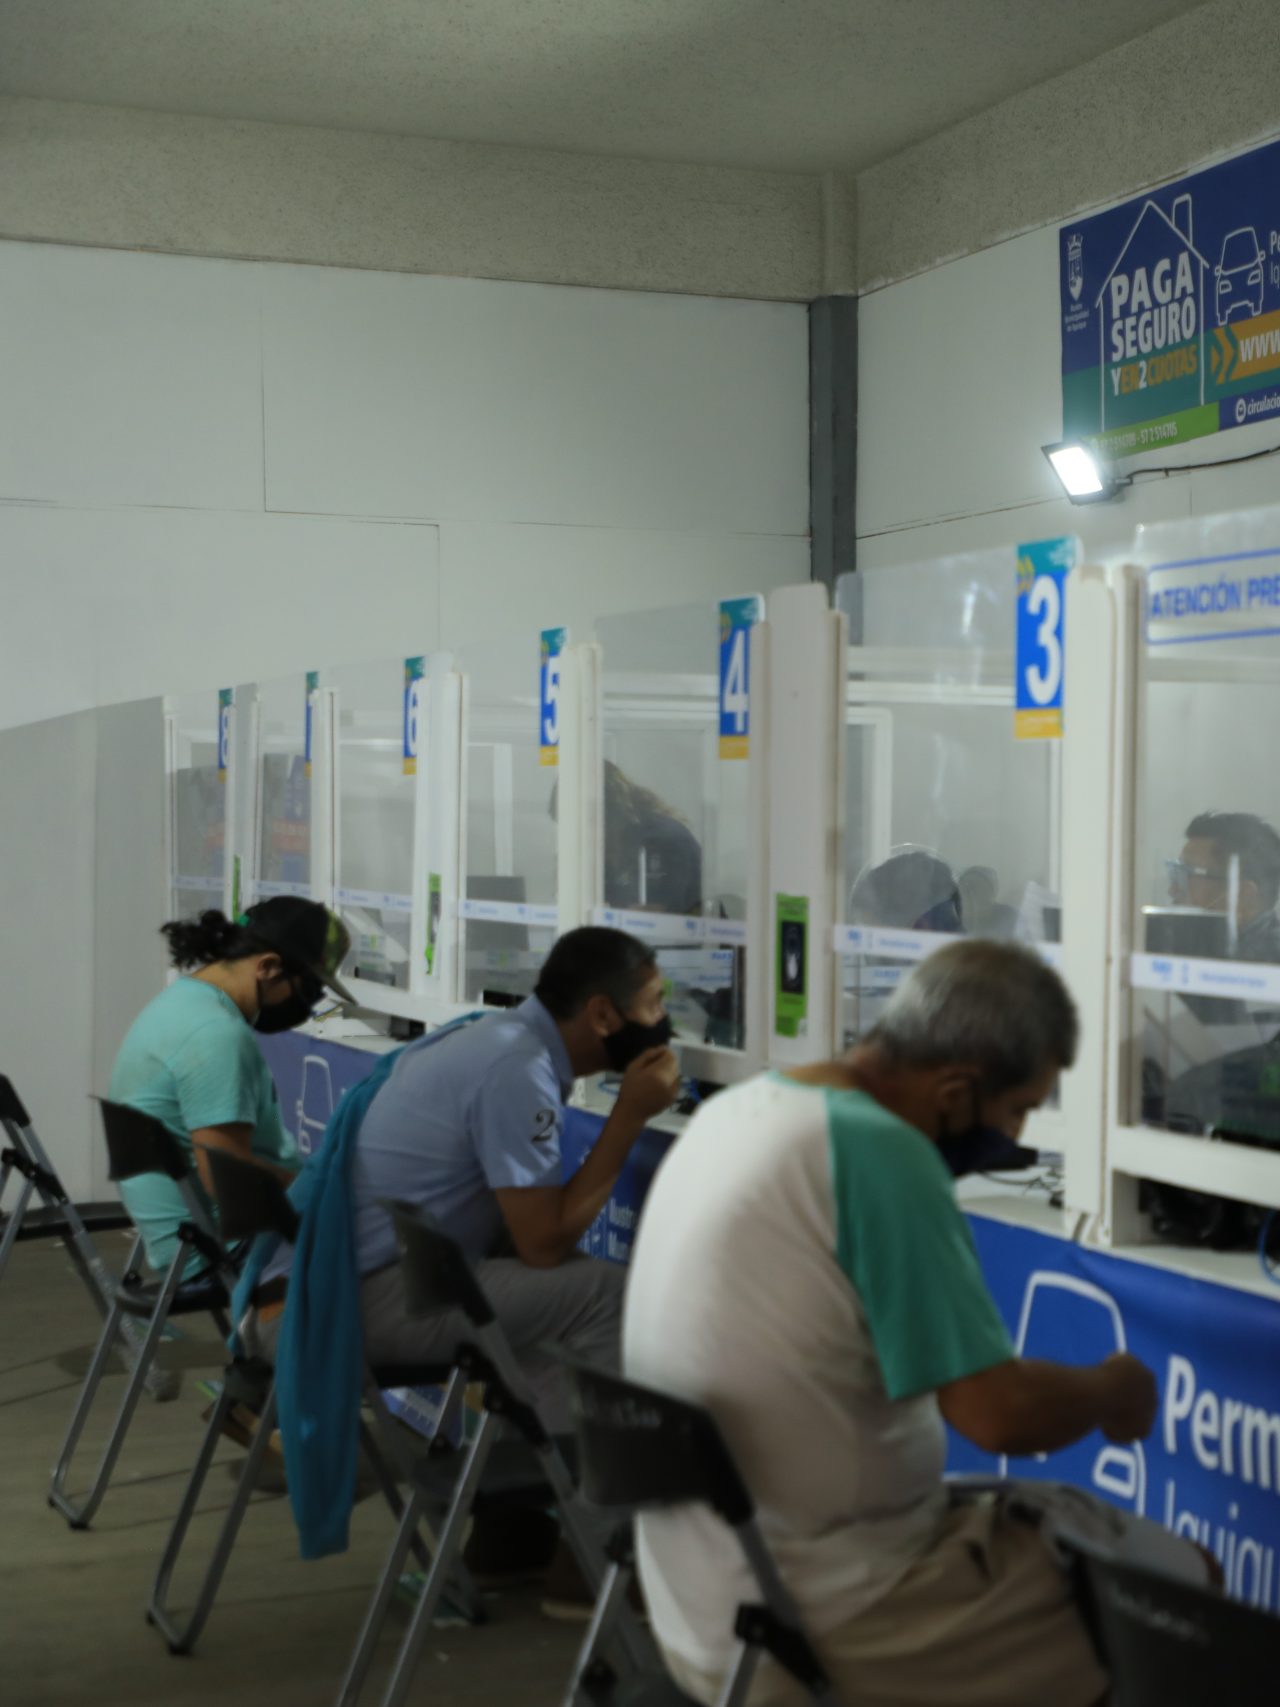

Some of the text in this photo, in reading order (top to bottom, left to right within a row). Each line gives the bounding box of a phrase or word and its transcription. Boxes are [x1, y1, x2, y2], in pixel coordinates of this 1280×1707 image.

[1111, 251, 1194, 320] PAGA
[1111, 296, 1196, 362] SEGURO
[1151, 572, 1241, 617] ATENCIÓN
[1025, 575, 1063, 705] 3
[546, 657, 560, 743] 5
[722, 629, 749, 734] 4
[531, 1109, 555, 1143] 2
